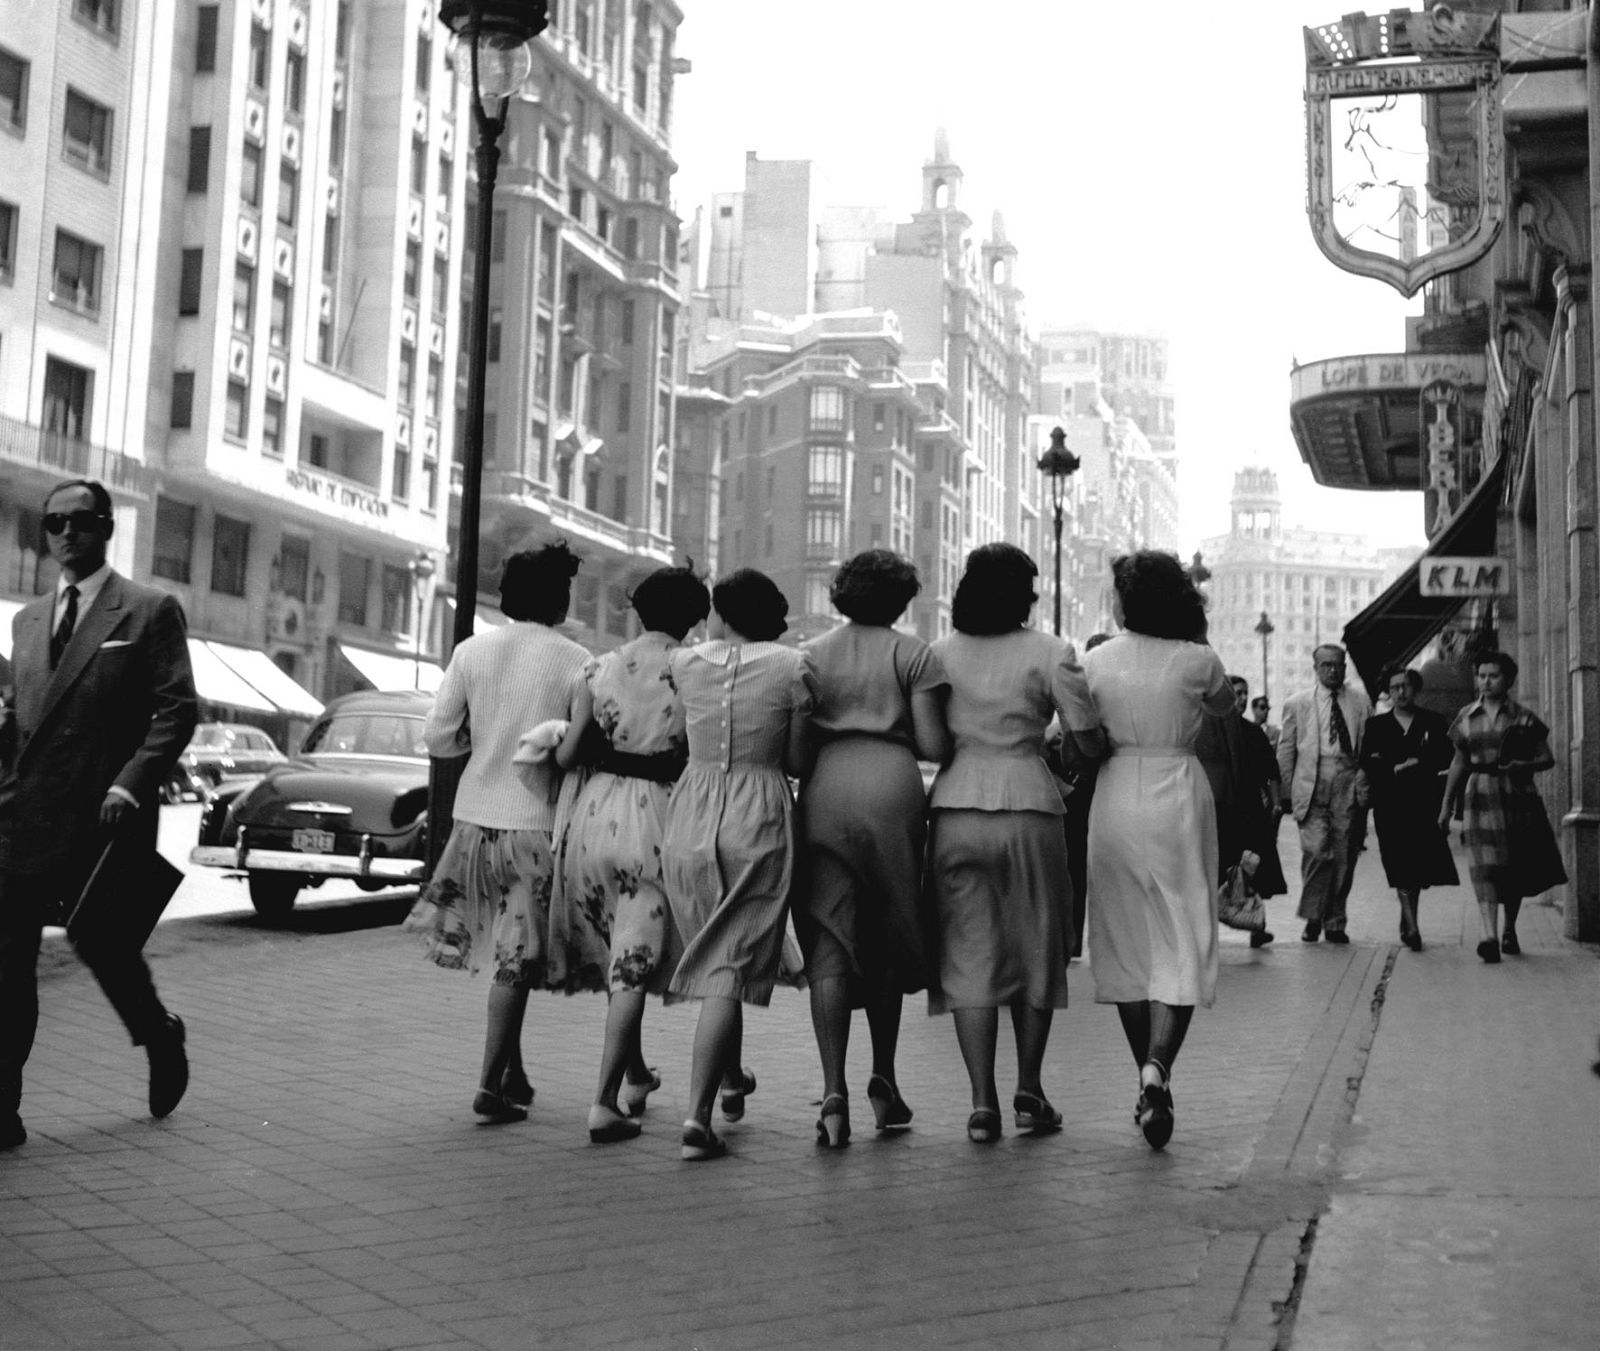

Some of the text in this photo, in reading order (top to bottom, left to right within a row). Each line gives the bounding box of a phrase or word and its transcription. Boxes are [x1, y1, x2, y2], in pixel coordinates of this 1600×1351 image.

[1321, 364, 1368, 387] LOPE
[1379, 363, 1404, 383] DE
[1428, 402, 1456, 535] IBERIA
[1426, 565, 1502, 589] KLM
